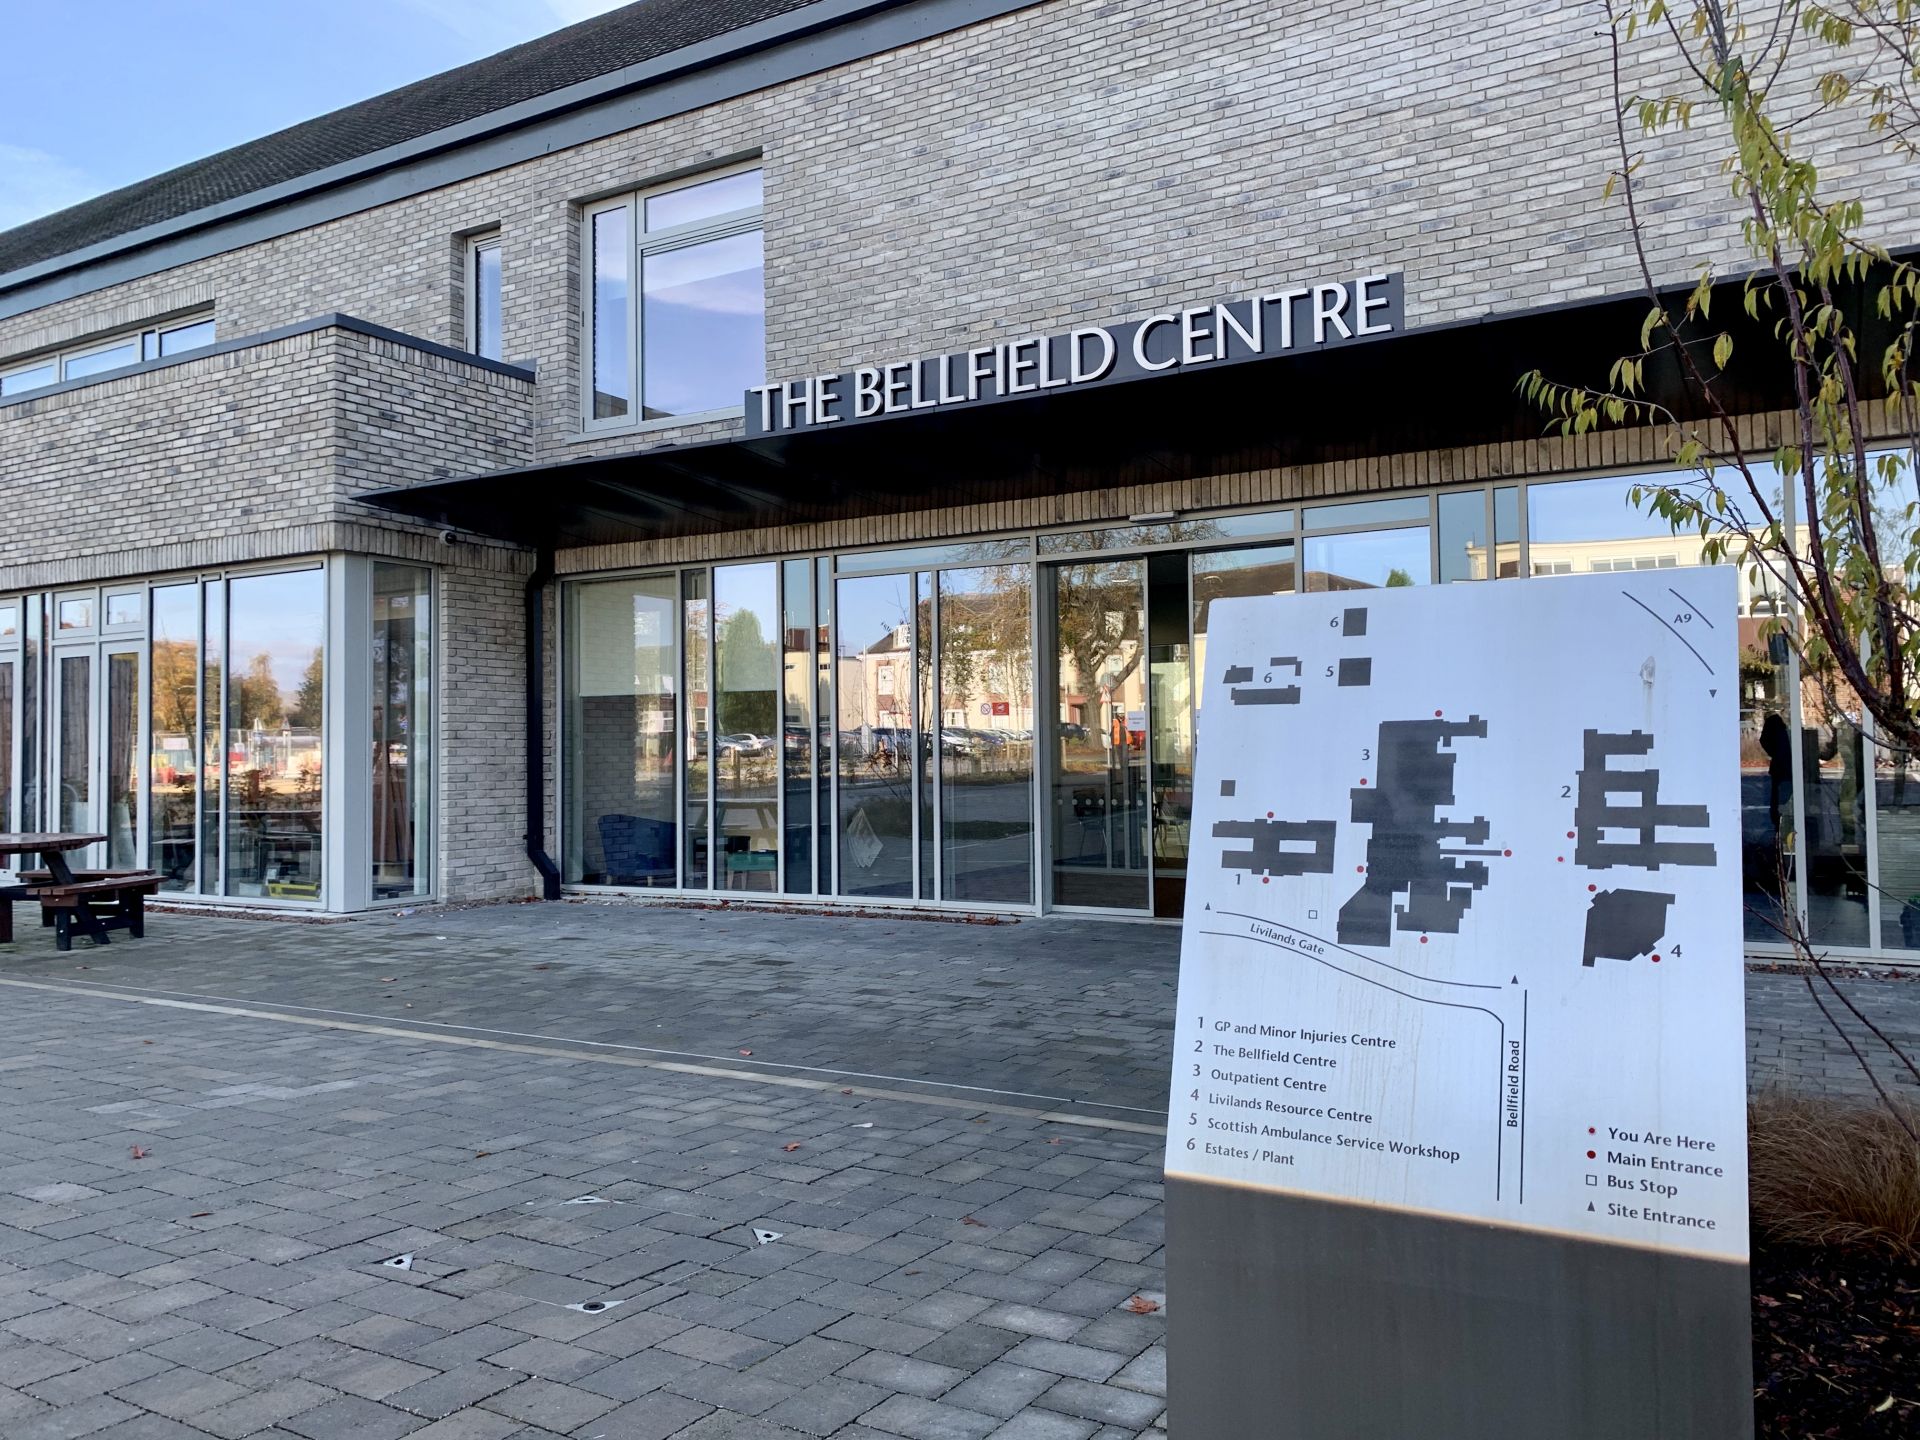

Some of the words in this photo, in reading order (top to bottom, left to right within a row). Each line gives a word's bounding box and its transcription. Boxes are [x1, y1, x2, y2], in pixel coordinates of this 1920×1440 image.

[750, 373, 841, 432] THE
[853, 326, 1115, 418] BELLFIELD
[1132, 273, 1393, 371] CENTRE
[1329, 616, 1339, 628] 6
[1673, 613, 1693, 624] A9
[1263, 671, 1273, 684] 6
[1325, 665, 1335, 678] 5
[1361, 748, 1371, 761] 3
[1560, 785, 1572, 799] 2
[1235, 873, 1241, 886] 1
[1249, 922, 1296, 946] Livilands
[1298, 939, 1325, 956] Gate
[1670, 943, 1683, 958] 4
[1197, 1016, 1204, 1029] 1
[1214, 1020, 1231, 1032] GP
[1233, 1023, 1257, 1035] and
[1259, 1024, 1297, 1039] Minor
[1300, 1028, 1348, 1045] Injuries
[1350, 1033, 1397, 1049] Centre
[1193, 1039, 1203, 1053] 2
[1212, 1044, 1236, 1058] The
[1238, 1047, 1290, 1063] Bellfield
[1292, 1052, 1337, 1069] Centre
[1507, 1039, 1520, 1073] Road
[1192, 1063, 1201, 1077] 3
[1210, 1068, 1280, 1088] Outpatient
[1283, 1076, 1327, 1093] Centre
[1190, 1088, 1200, 1102] 4
[1208, 1092, 1262, 1110] Livilands
[1265, 1099, 1324, 1118] Resource
[1326, 1107, 1373, 1124] Centre
[1506, 1075, 1519, 1128] Bellfield
[1186, 1137, 1196, 1151] 6
[1205, 1142, 1249, 1159] Estates
[1252, 1148, 1259, 1161] /
[1262, 1150, 1295, 1166] Plant
[1188, 1112, 1198, 1126] 5
[1207, 1117, 1258, 1135] Scottish
[1260, 1124, 1333, 1145] Ambulance
[1335, 1134, 1385, 1152] Service
[1388, 1140, 1461, 1165] Workshop
[1608, 1126, 1639, 1143] You
[1643, 1131, 1672, 1147] Are
[1676, 1134, 1716, 1152] Here
[1607, 1150, 1647, 1168] Main
[1650, 1156, 1724, 1178] Entrance
[1607, 1174, 1635, 1191] Bus
[1639, 1178, 1678, 1200] Stop
[1607, 1202, 1639, 1219] Site
[1643, 1207, 1716, 1231] Entrance
